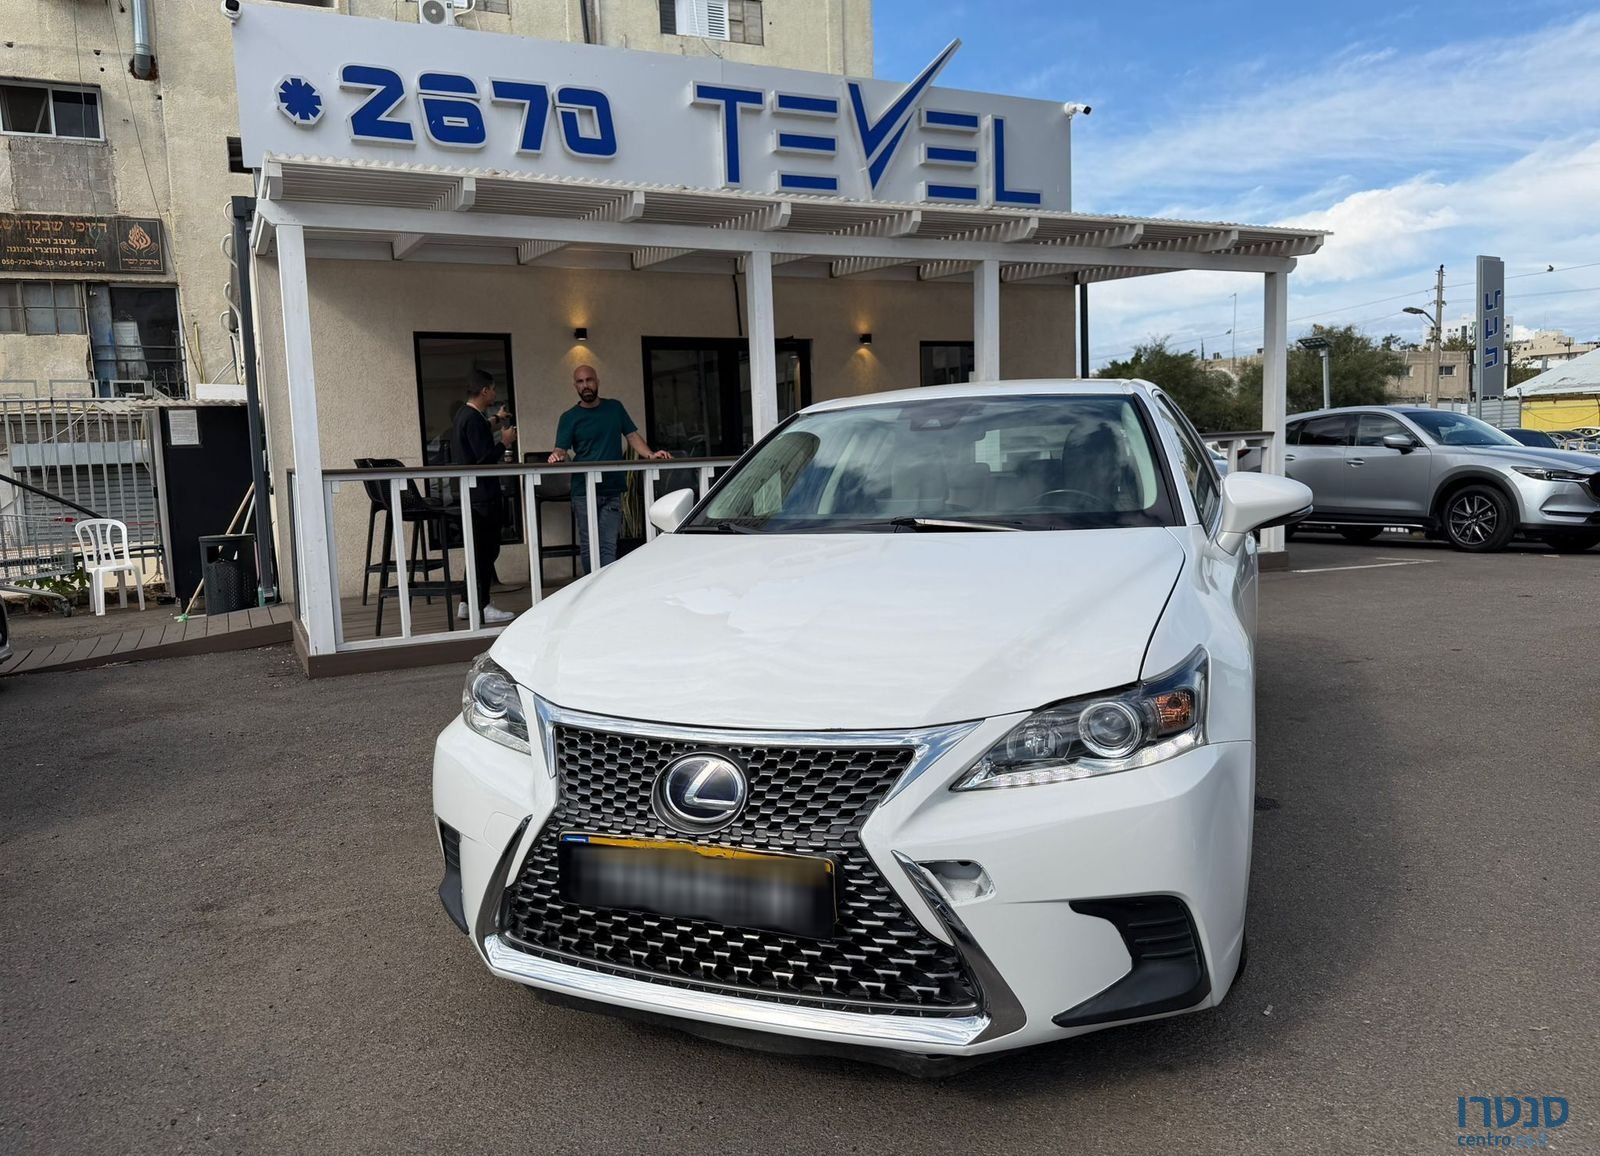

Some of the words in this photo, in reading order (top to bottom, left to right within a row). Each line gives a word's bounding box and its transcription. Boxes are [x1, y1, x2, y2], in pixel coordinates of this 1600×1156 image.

[692, 38, 1042, 206] TEVEL
[0, 218, 63, 234] שבקדוש
[7, 245, 32, 253] אמונה
[35, 246, 62, 254] ומוצרי
[64, 247, 98, 255] יודאיקה
[1485, 290, 1501, 367] תבל
